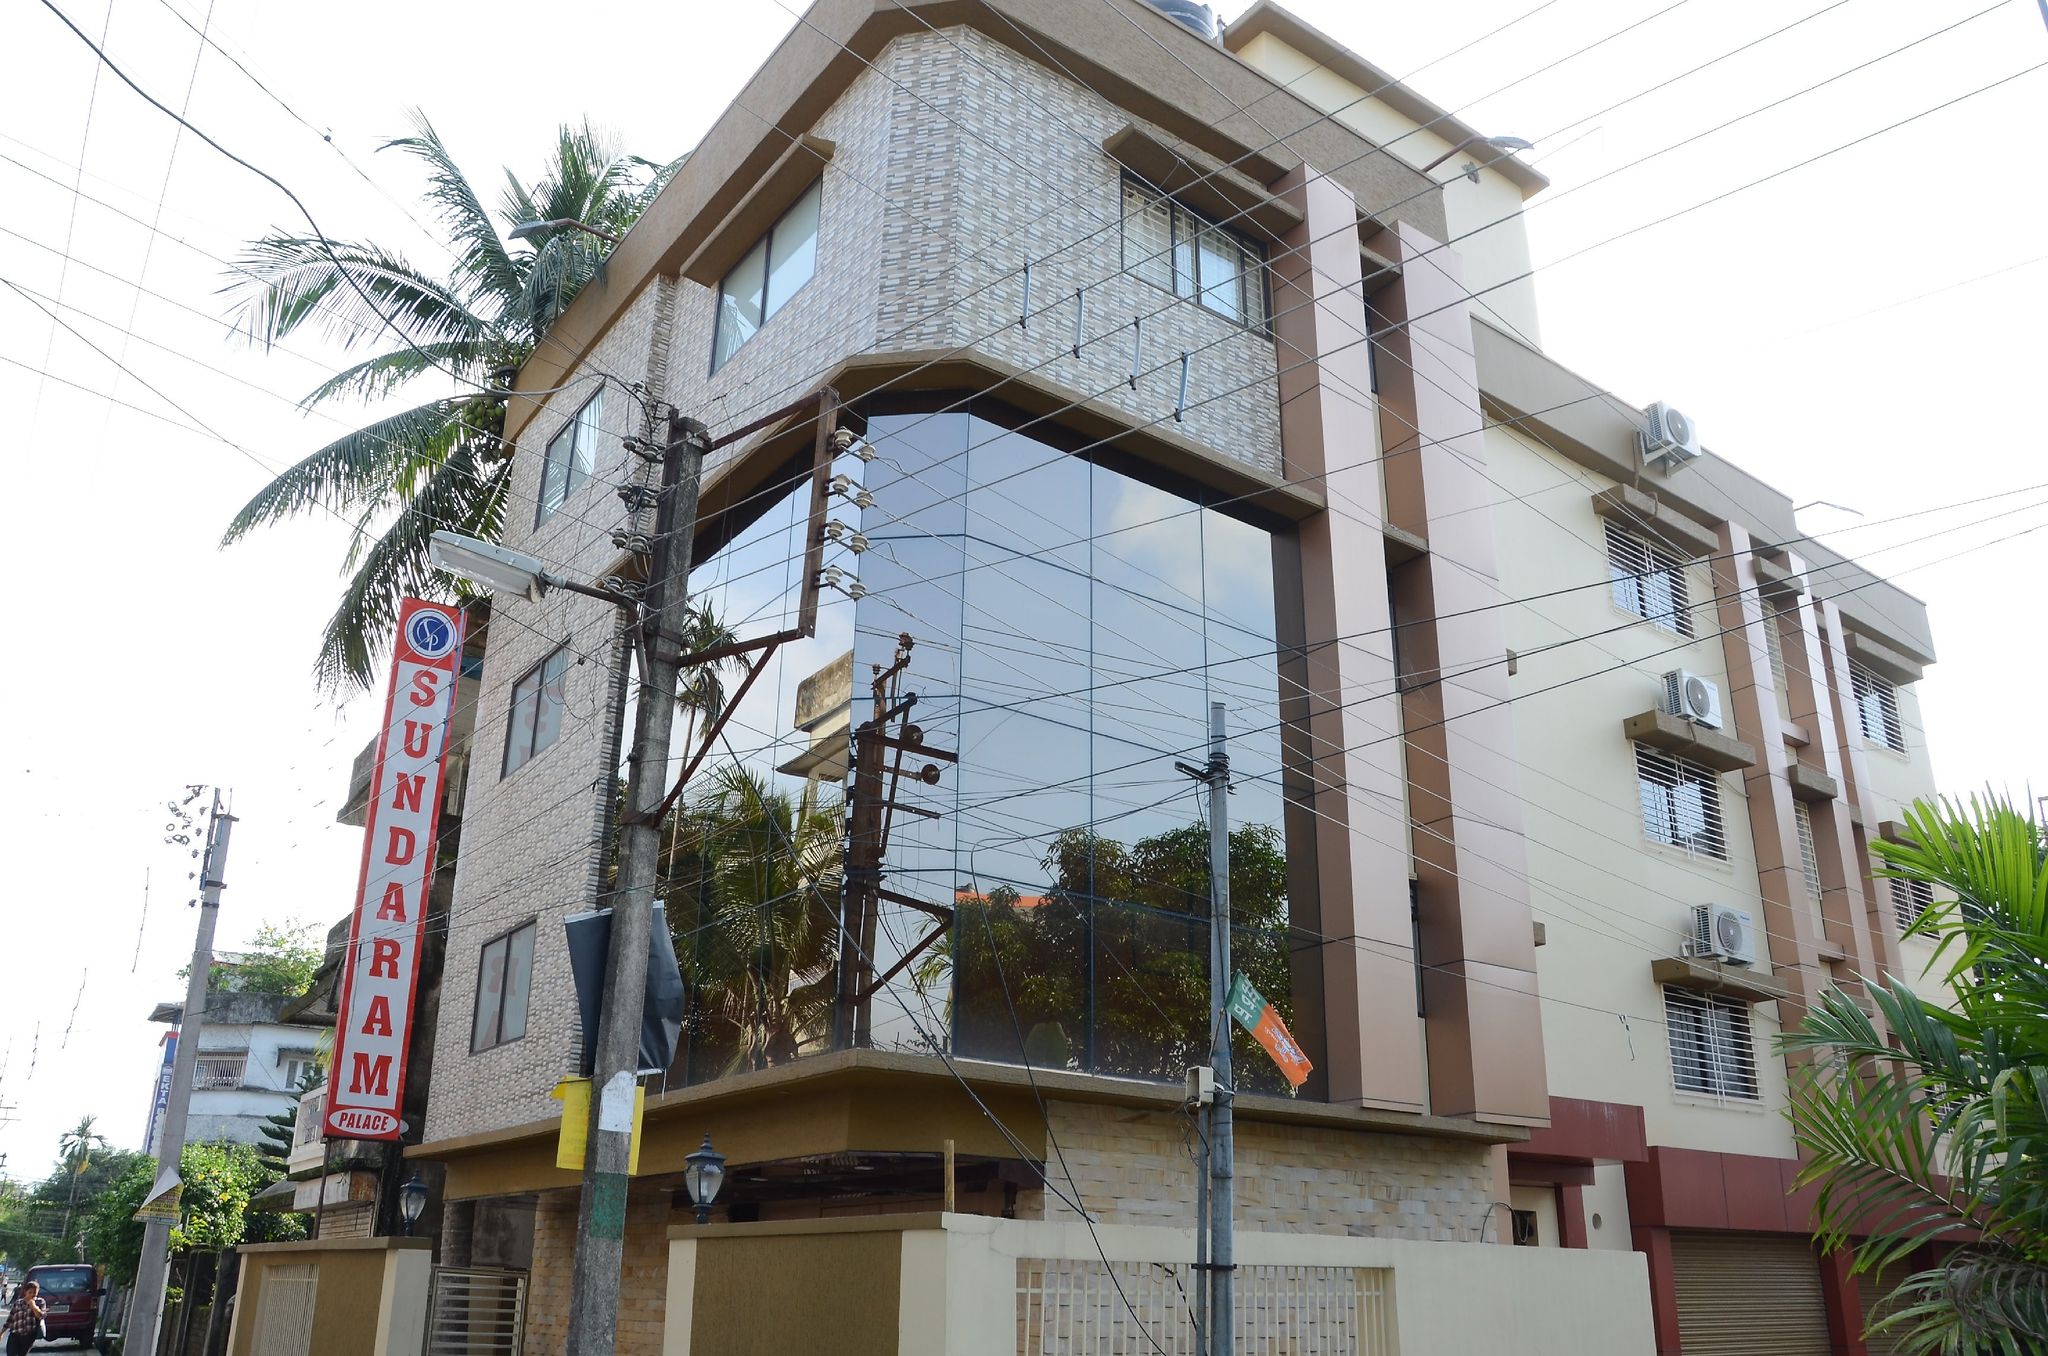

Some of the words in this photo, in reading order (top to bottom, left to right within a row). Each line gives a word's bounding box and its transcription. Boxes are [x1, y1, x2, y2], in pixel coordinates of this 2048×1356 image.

[348, 669, 439, 1097] SUNDARAM
[158, 1075, 170, 1105] EKTA
[338, 1111, 389, 1131] PALACE
